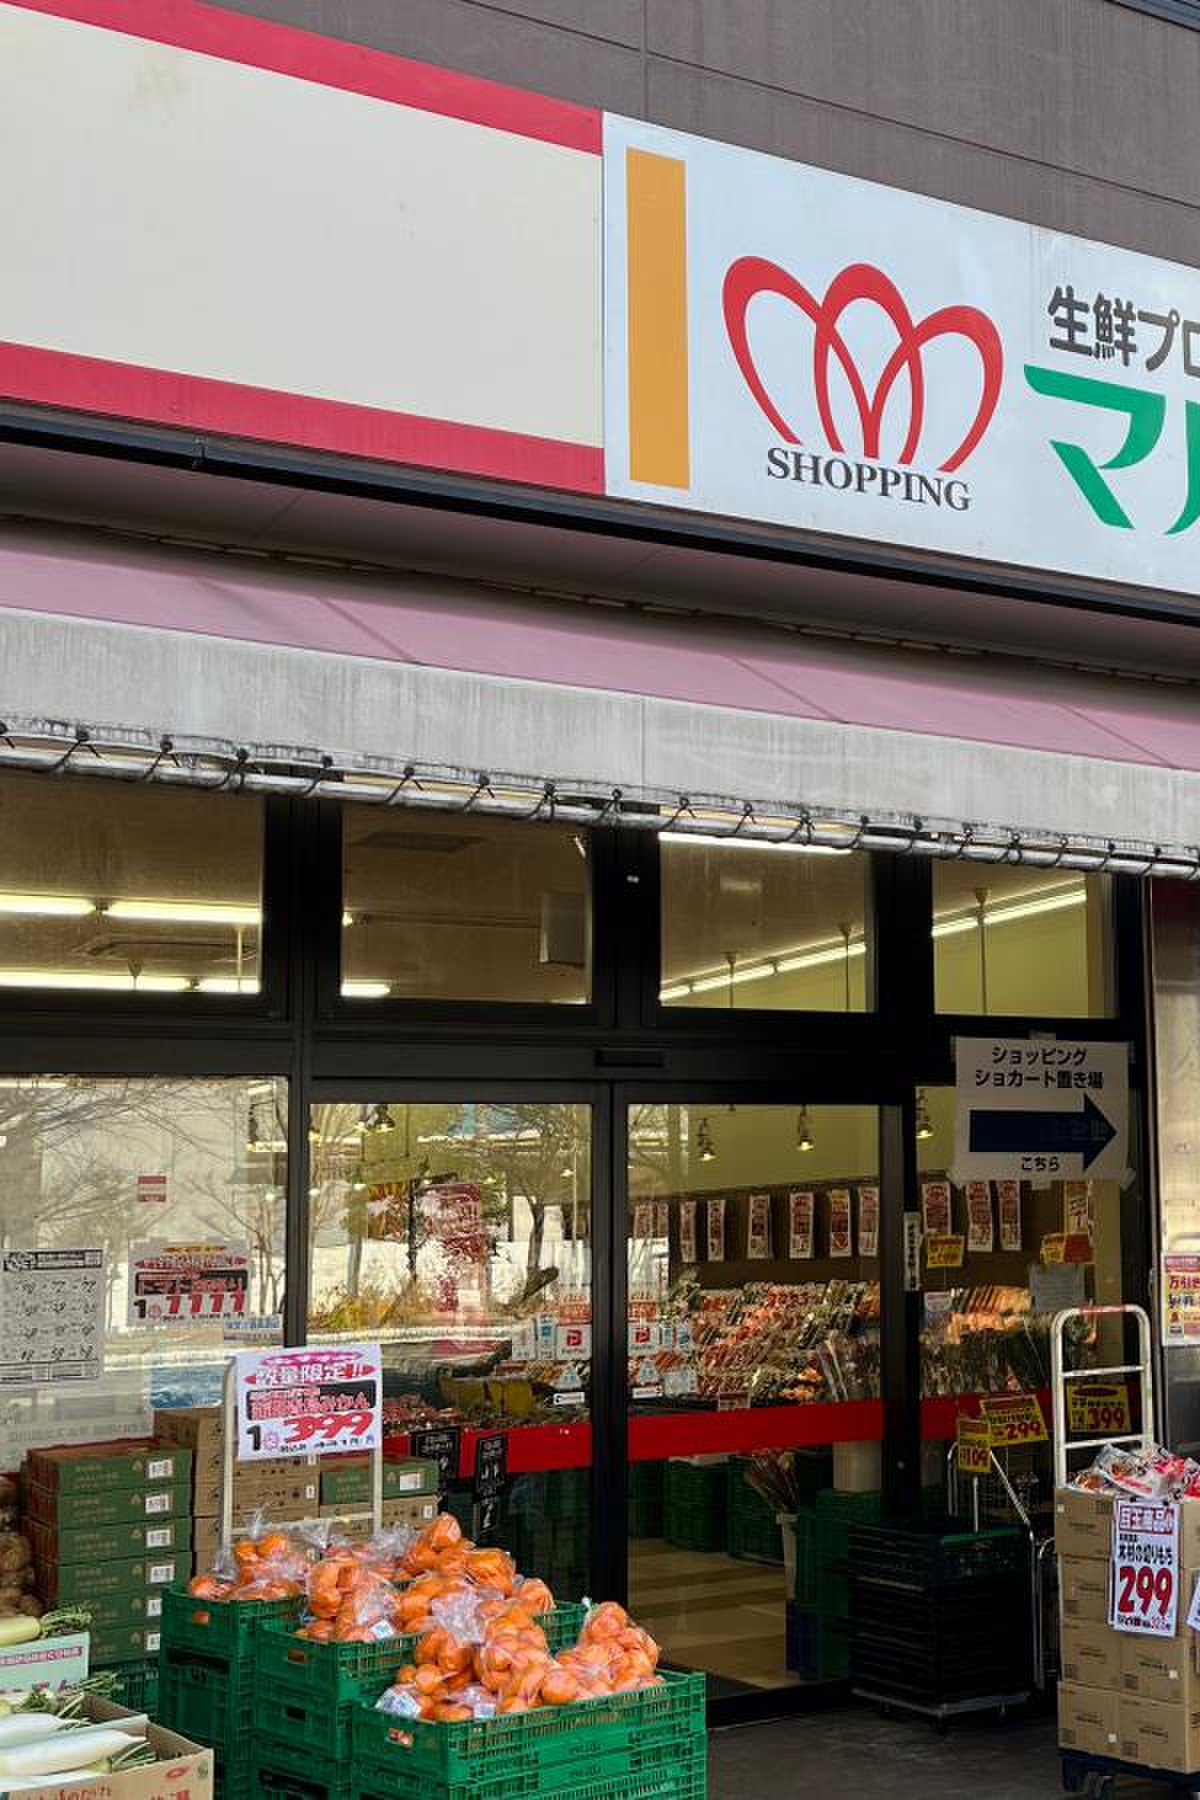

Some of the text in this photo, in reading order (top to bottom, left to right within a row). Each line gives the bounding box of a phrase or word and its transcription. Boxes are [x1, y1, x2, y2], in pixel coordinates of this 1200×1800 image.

[765, 445, 971, 512] SHOPPING
[992, 1046, 1087, 1066] ショッピング
[976, 1069, 1103, 1088] ショカート置き場
[1021, 1156, 1060, 1171] こちら
[1087, 1407, 1124, 1430] 399
[246, 1425, 262, 1451] 1
[1006, 1422, 1041, 1441] 299
[1118, 1566, 1173, 1616] 299
